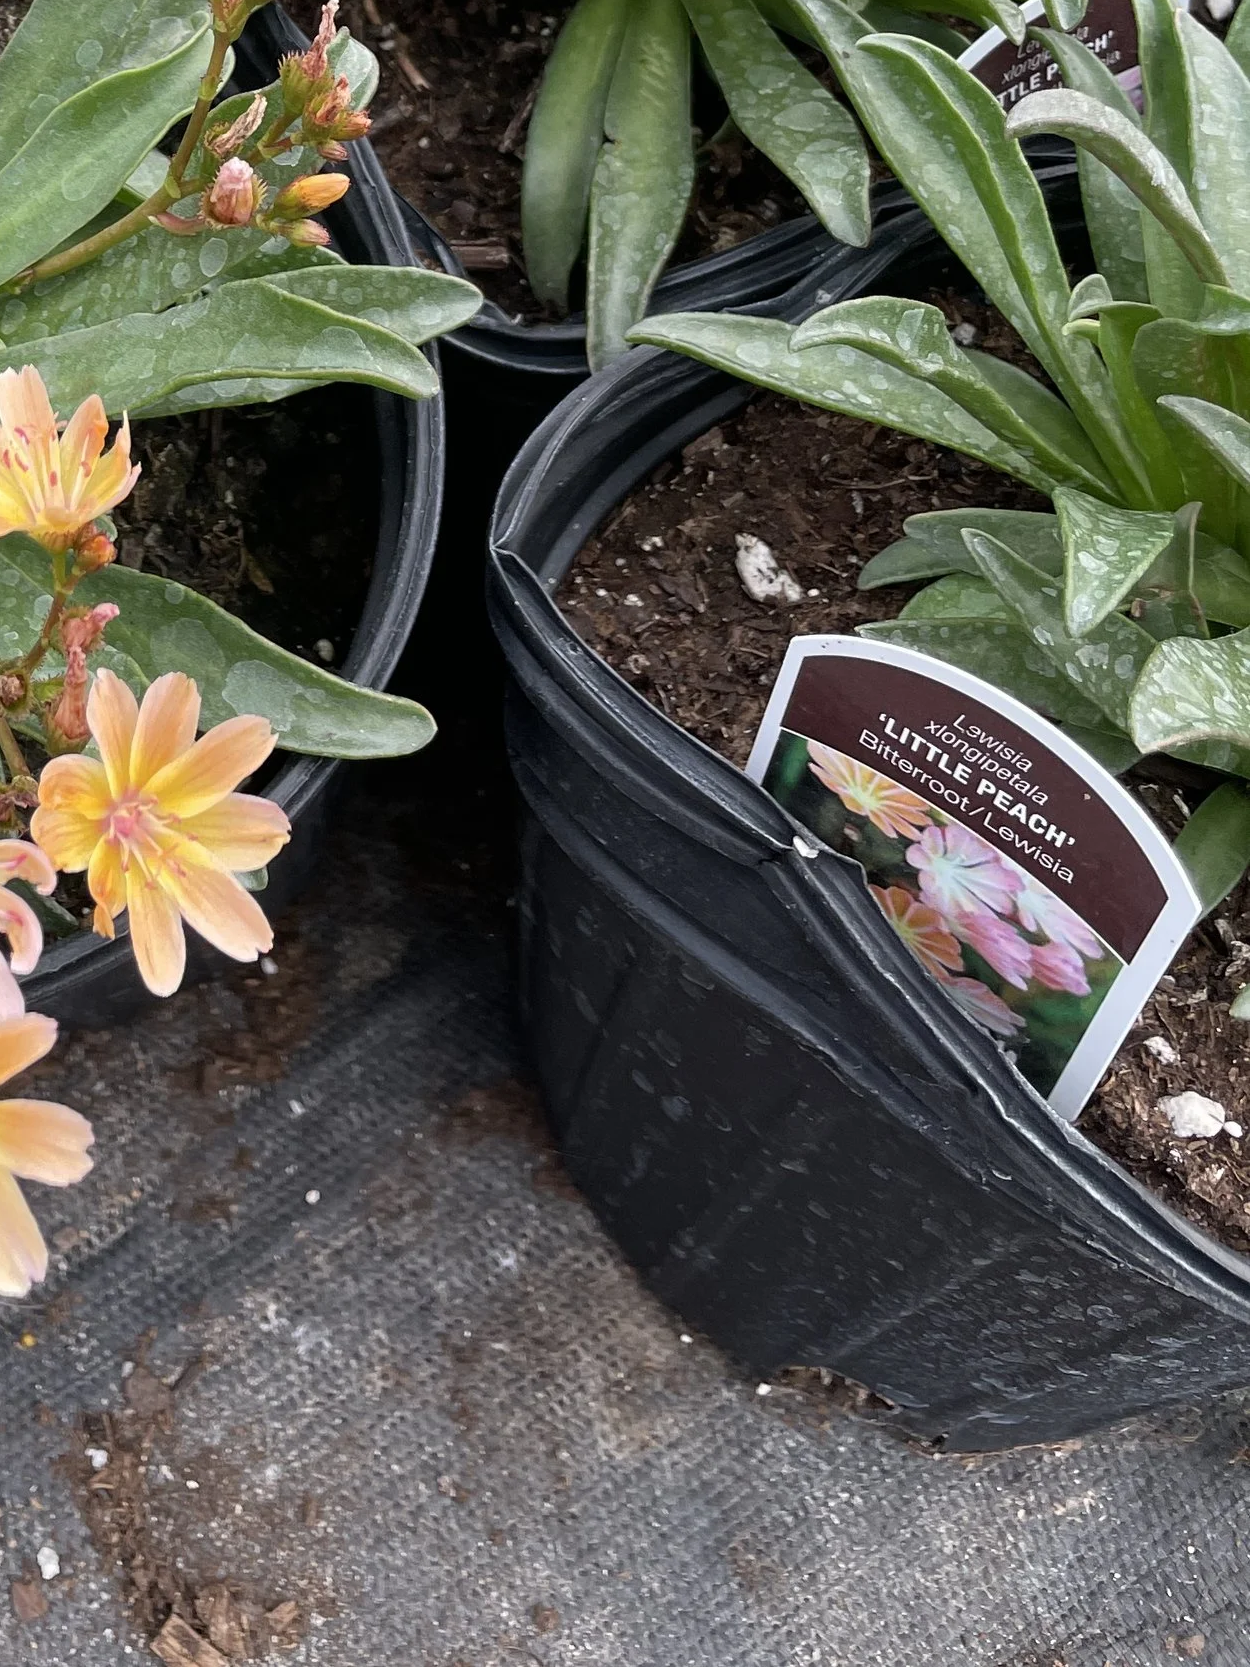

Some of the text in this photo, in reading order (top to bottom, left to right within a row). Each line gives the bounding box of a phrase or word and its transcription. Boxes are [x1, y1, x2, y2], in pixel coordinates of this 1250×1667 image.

[878, 713, 1075, 848] 'LITTLE PEACH'
[924, 720, 1048, 806] xlongipetala
[953, 714, 1033, 773] Lewisia
